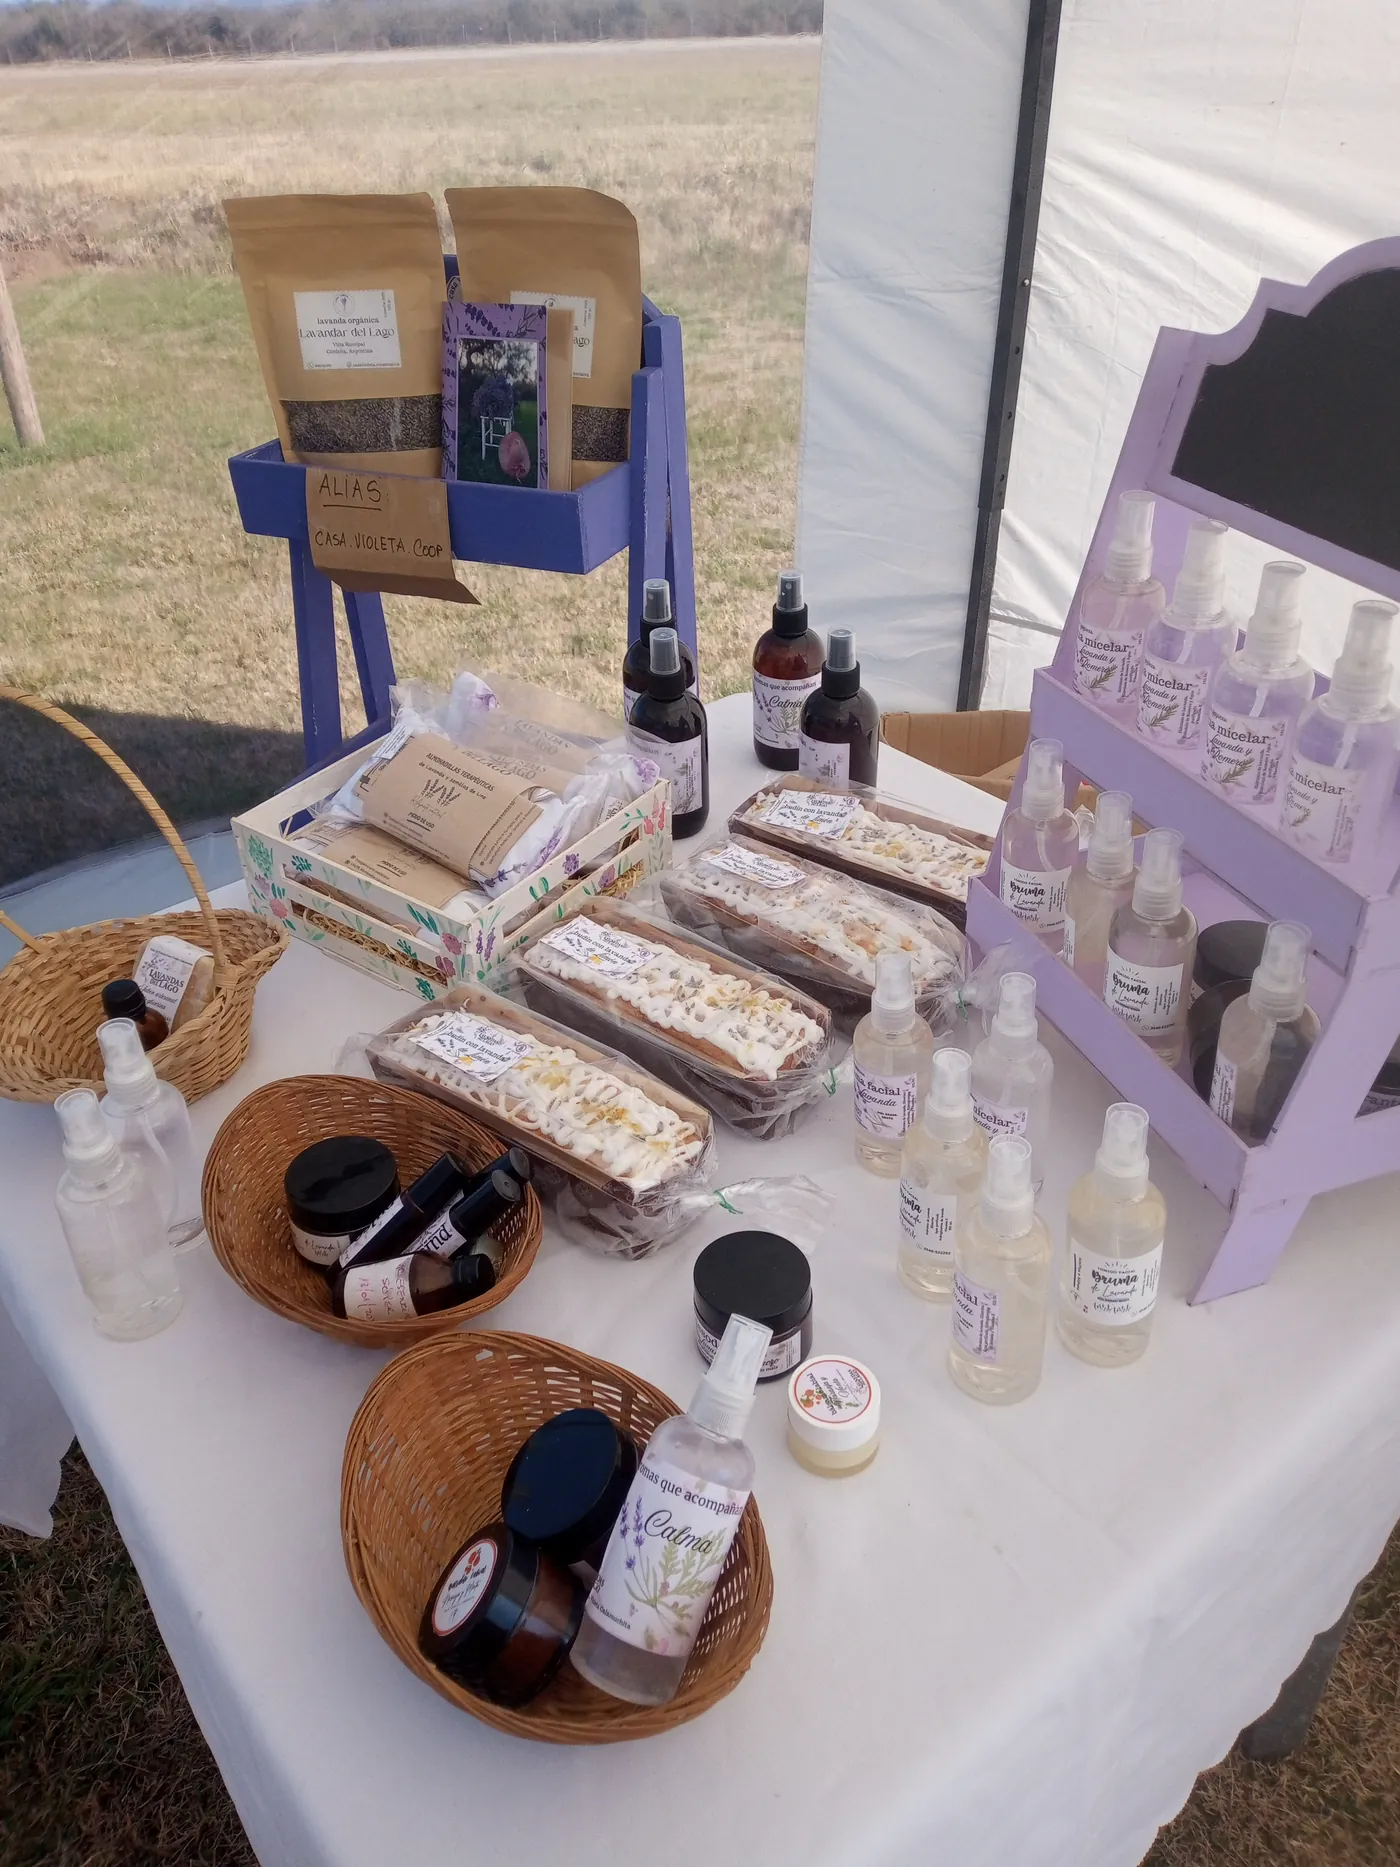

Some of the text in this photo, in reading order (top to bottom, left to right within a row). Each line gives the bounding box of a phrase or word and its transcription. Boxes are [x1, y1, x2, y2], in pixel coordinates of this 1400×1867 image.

[317, 316, 380, 326] lavanda orgánica
[350, 327, 367, 337] del
[369, 327, 395, 339] Lago
[1084, 636, 1130, 653] micelar
[1079, 645, 1116, 664] Lavanda y
[1142, 680, 1170, 699] Lavanda
[1146, 671, 1193, 691] micelar
[1216, 724, 1270, 745] micelar
[1210, 733, 1253, 757] Lavanda y
[1294, 771, 1346, 795] micelar
[1010, 880, 1046, 898] Bruma
[149, 969, 185, 988] LAVANDAS
[159, 980, 179, 994] LAGO
[1112, 972, 1151, 996] Bruma
[858, 1088, 897, 1107] Lavanda
[867, 1081, 901, 1096] facial
[1091, 1269, 1139, 1287] Bruma
[660, 1479, 683, 1497] que
[643, 1509, 713, 1554] Calma
